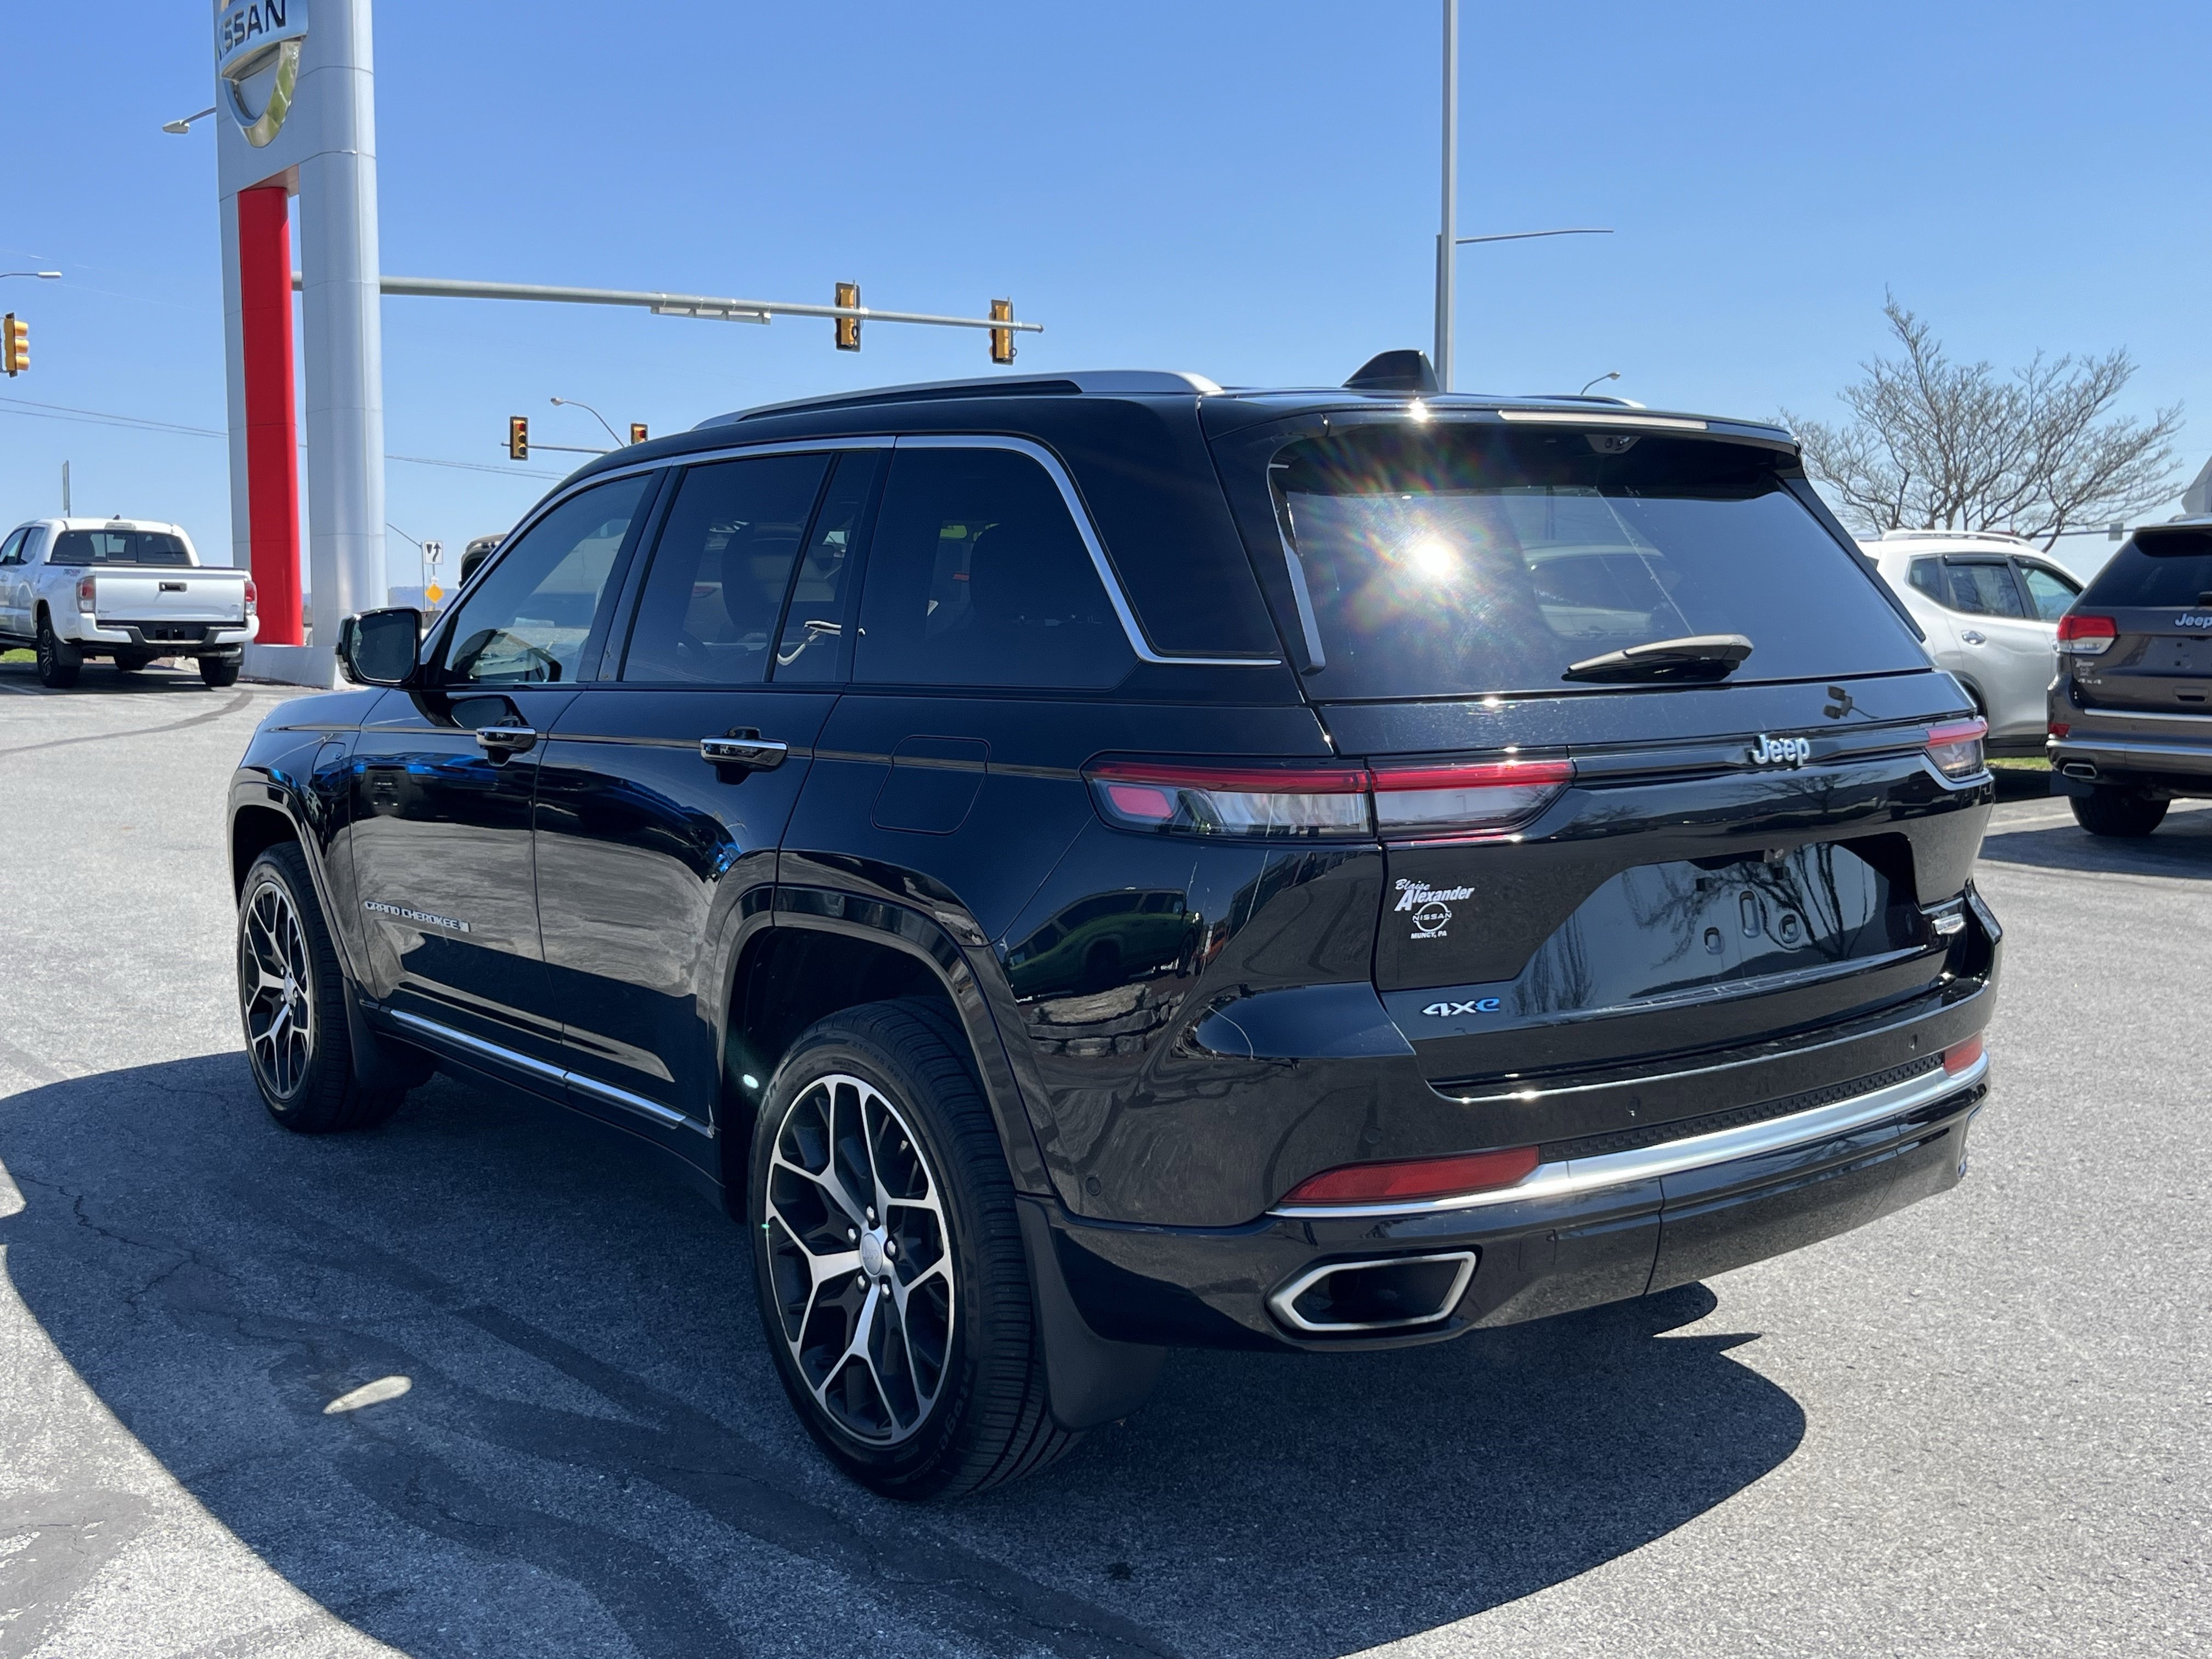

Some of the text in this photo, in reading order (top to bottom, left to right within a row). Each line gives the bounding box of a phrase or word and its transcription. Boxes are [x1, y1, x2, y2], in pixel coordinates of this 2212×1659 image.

[218, 0, 286, 61] ISSAN
[1751, 734, 1810, 766] Jeep
[1393, 885, 1475, 911] Alexander
[1395, 878, 1431, 890] Blaise
[364, 900, 461, 930] GRAND CHEROKEE
[1412, 911, 1453, 922] NISSAN
